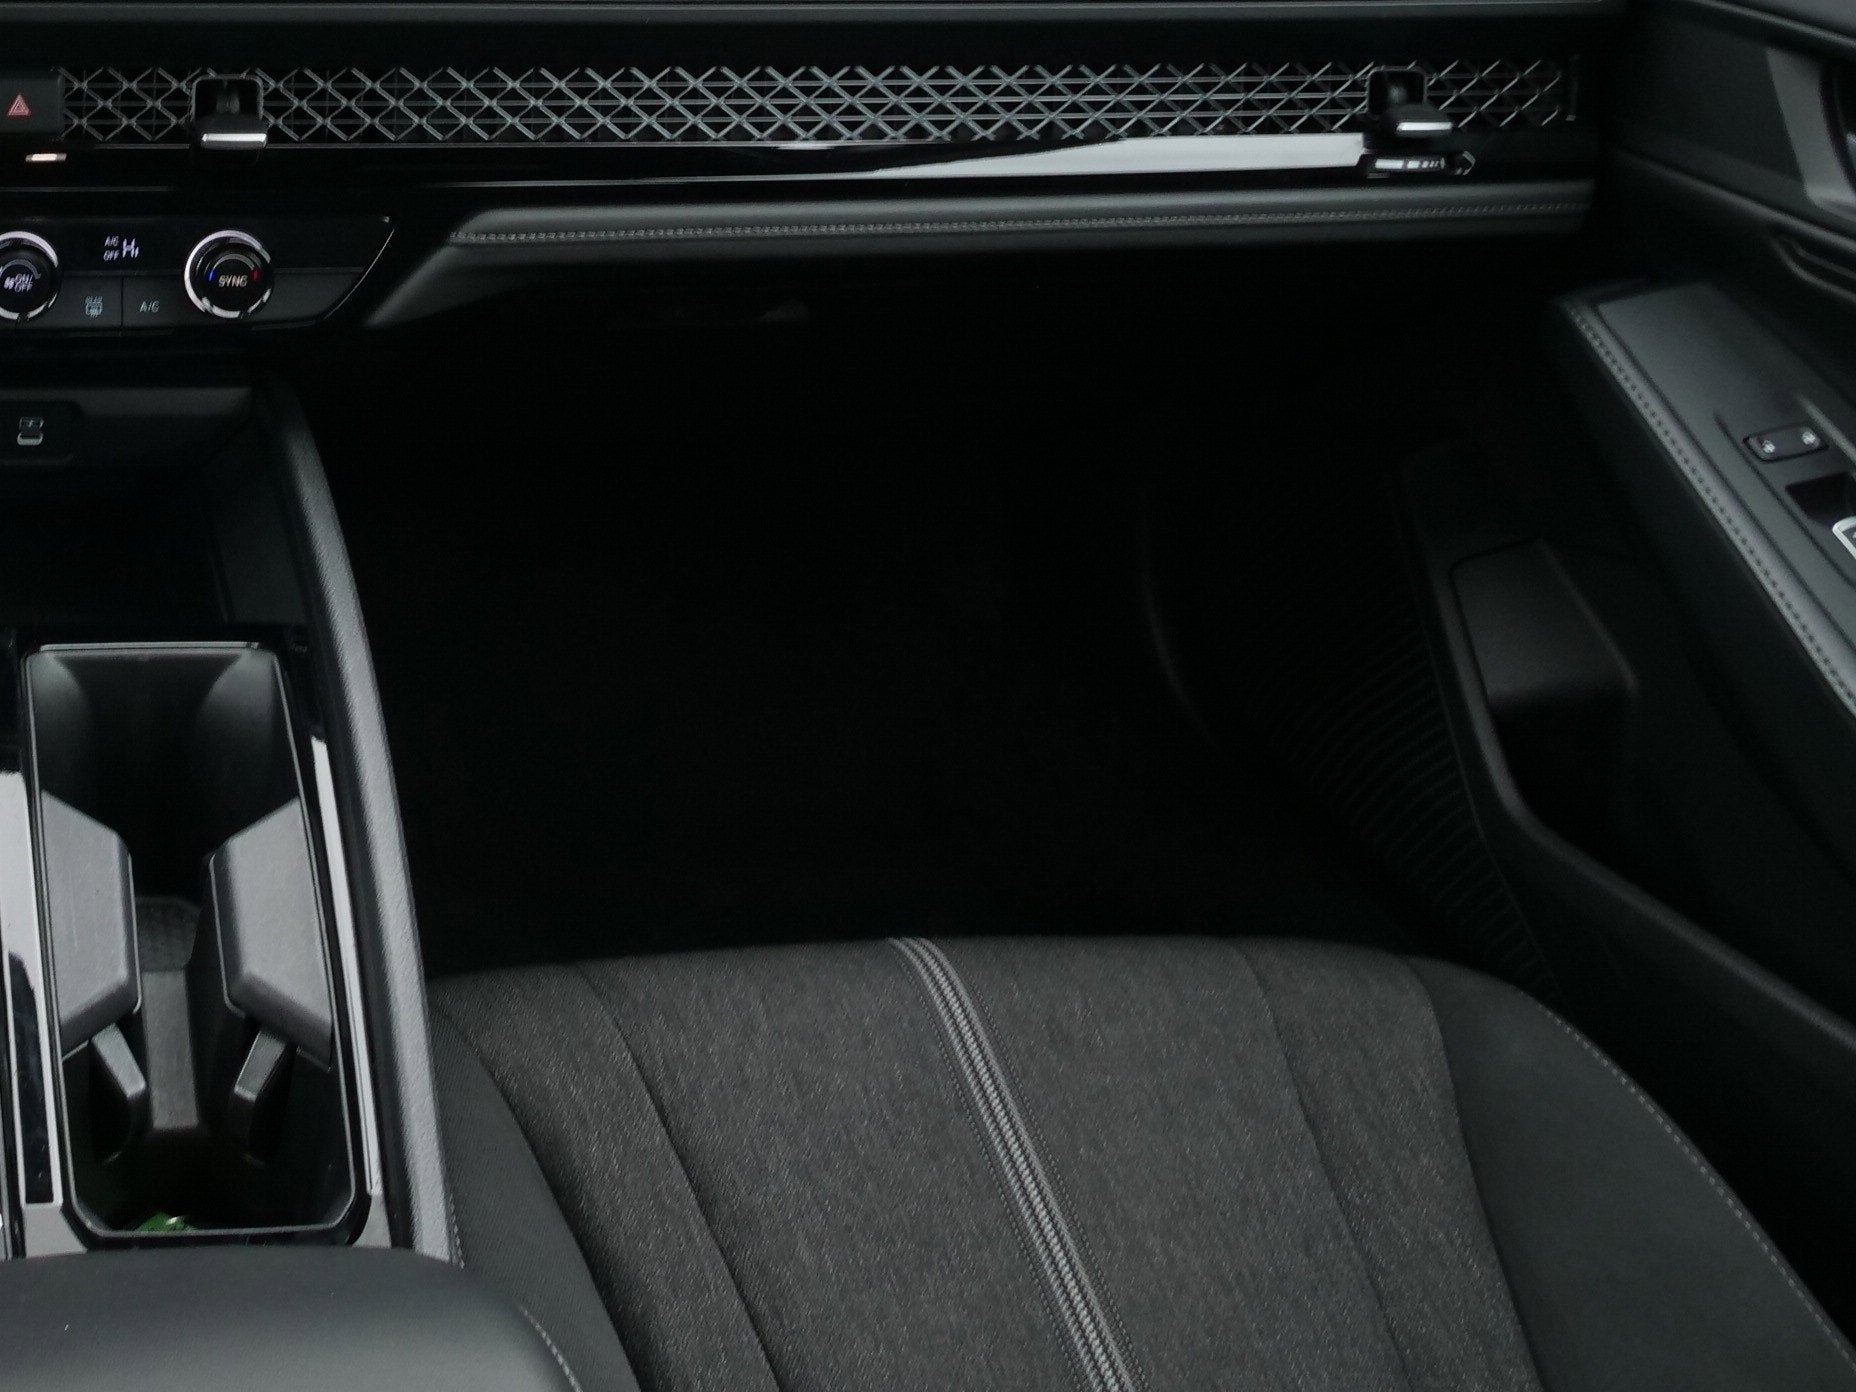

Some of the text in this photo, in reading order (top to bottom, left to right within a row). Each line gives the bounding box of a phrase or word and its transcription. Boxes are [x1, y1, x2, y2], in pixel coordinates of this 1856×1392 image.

[103, 249, 120, 261] OFF
[218, 275, 248, 288] SYNC
[139, 300, 160, 313] A/C
